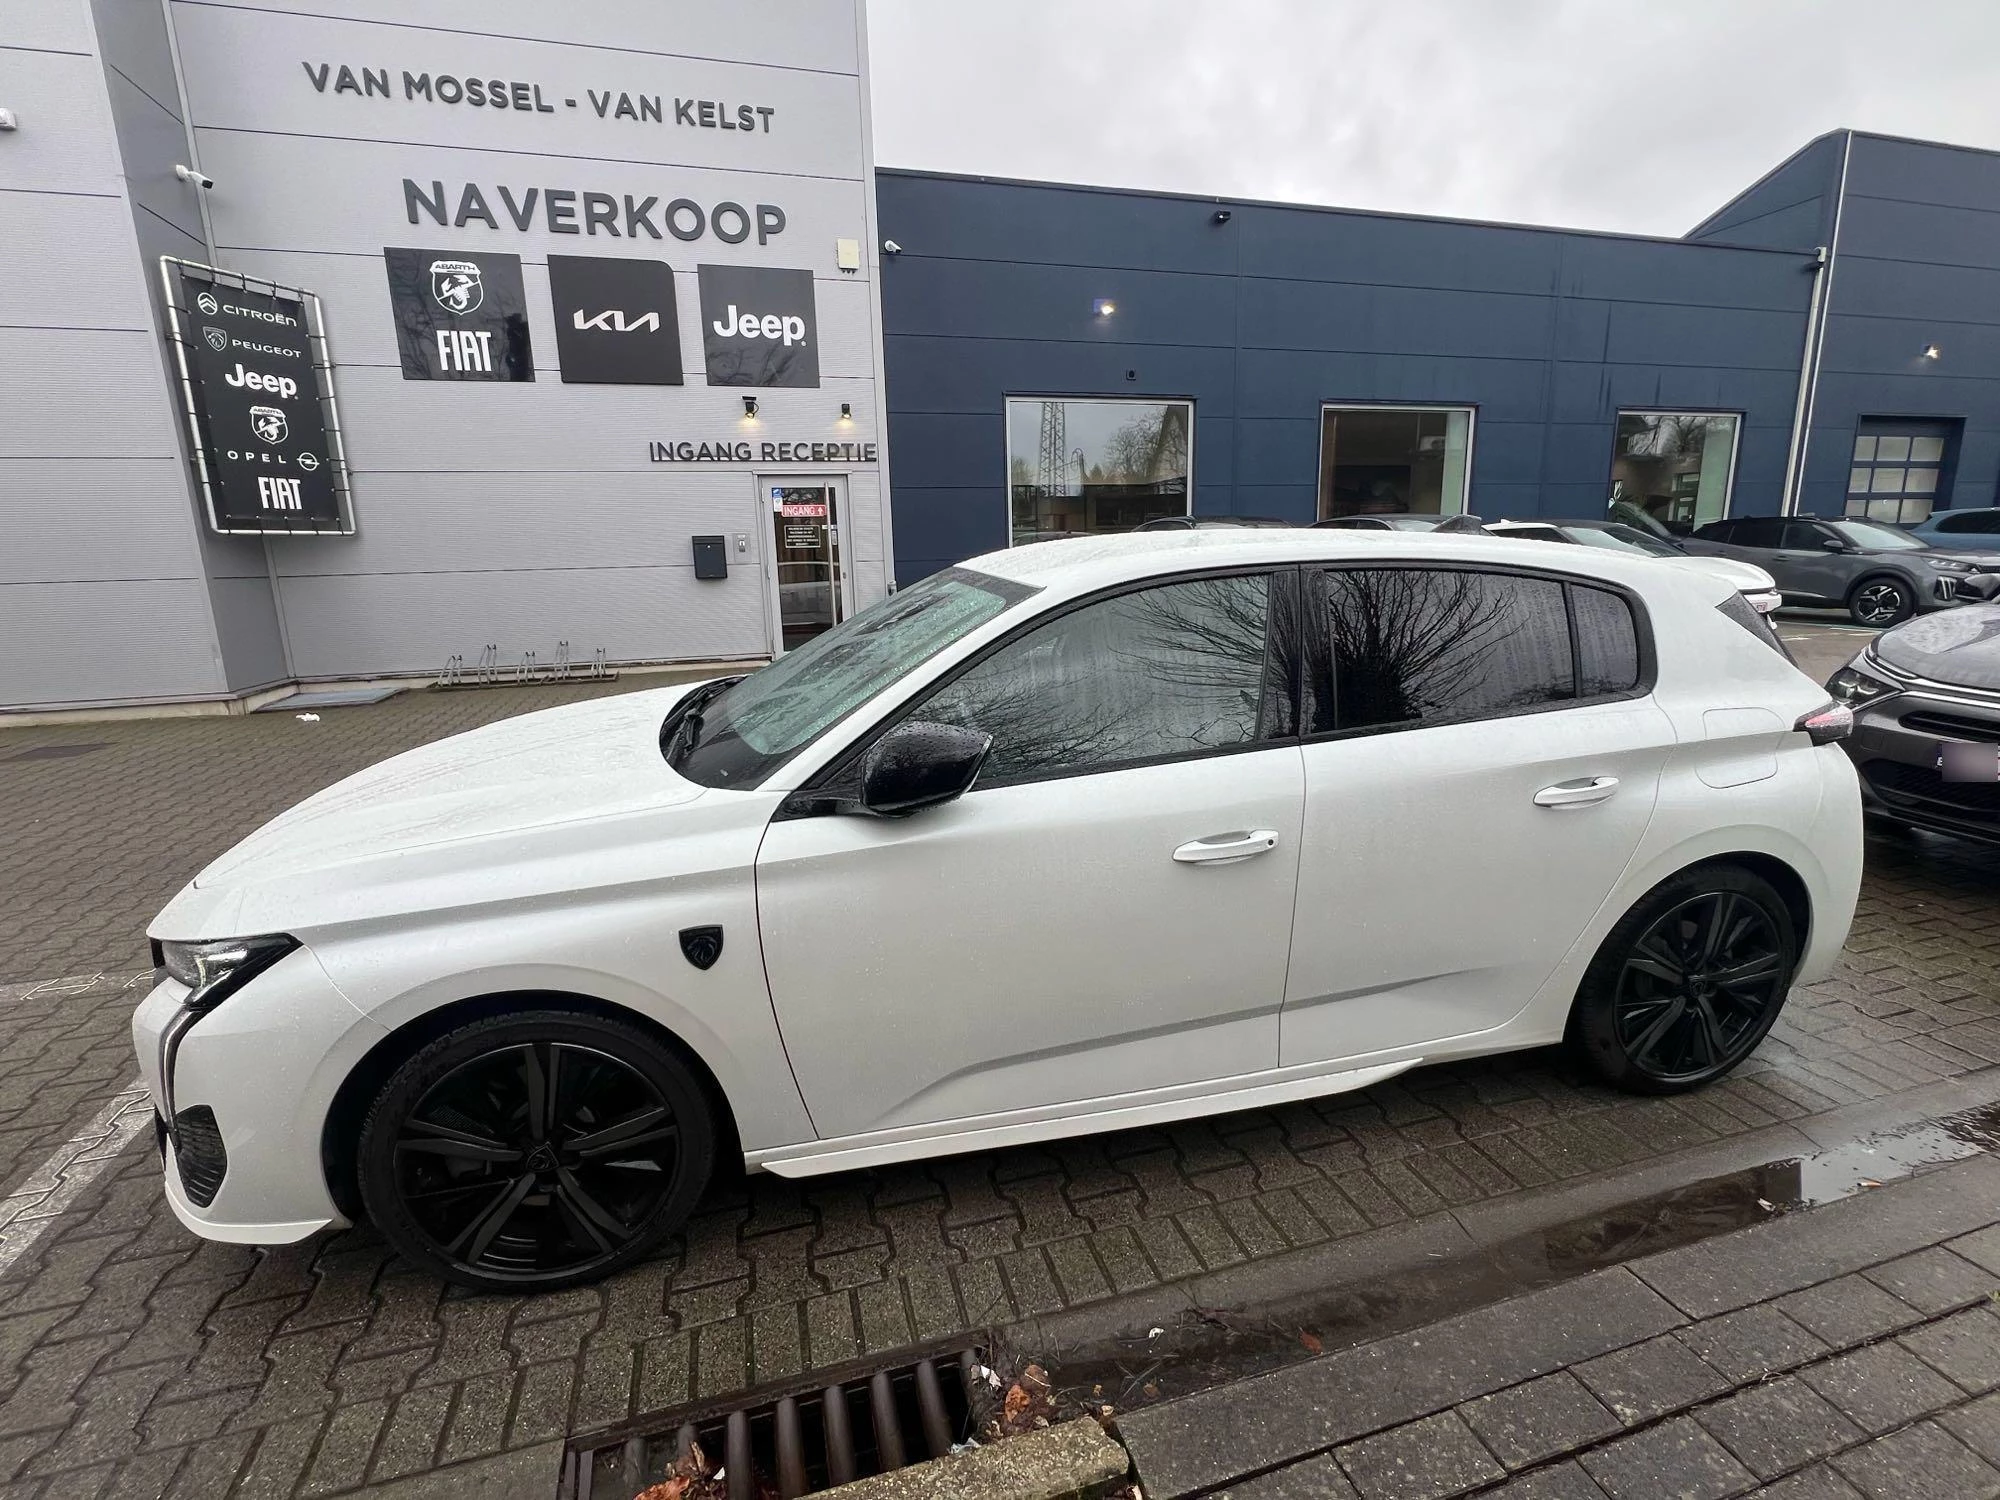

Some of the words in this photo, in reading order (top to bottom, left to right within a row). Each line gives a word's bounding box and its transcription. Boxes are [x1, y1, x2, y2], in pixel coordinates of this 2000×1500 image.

[302, 61, 390, 98] VAN
[403, 70, 554, 113] MOSSEL
[565, 98, 577, 107] -
[587, 88, 662, 123] VAN
[674, 97, 775, 133] KELST
[402, 178, 787, 246] NAVERKOOP
[434, 263, 476, 271] ABARTH
[222, 303, 298, 328] CITROËN
[713, 304, 806, 347] Jeep
[232, 338, 302, 359] PEUGEOT
[436, 328, 493, 372] FIAT
[225, 363, 298, 399] Jeep
[227, 450, 286, 464] OPEL
[649, 441, 752, 461] INGANG
[761, 442, 877, 462] RECEPTIE
[258, 476, 303, 510] FIAT
[784, 506, 815, 516] INGANG
